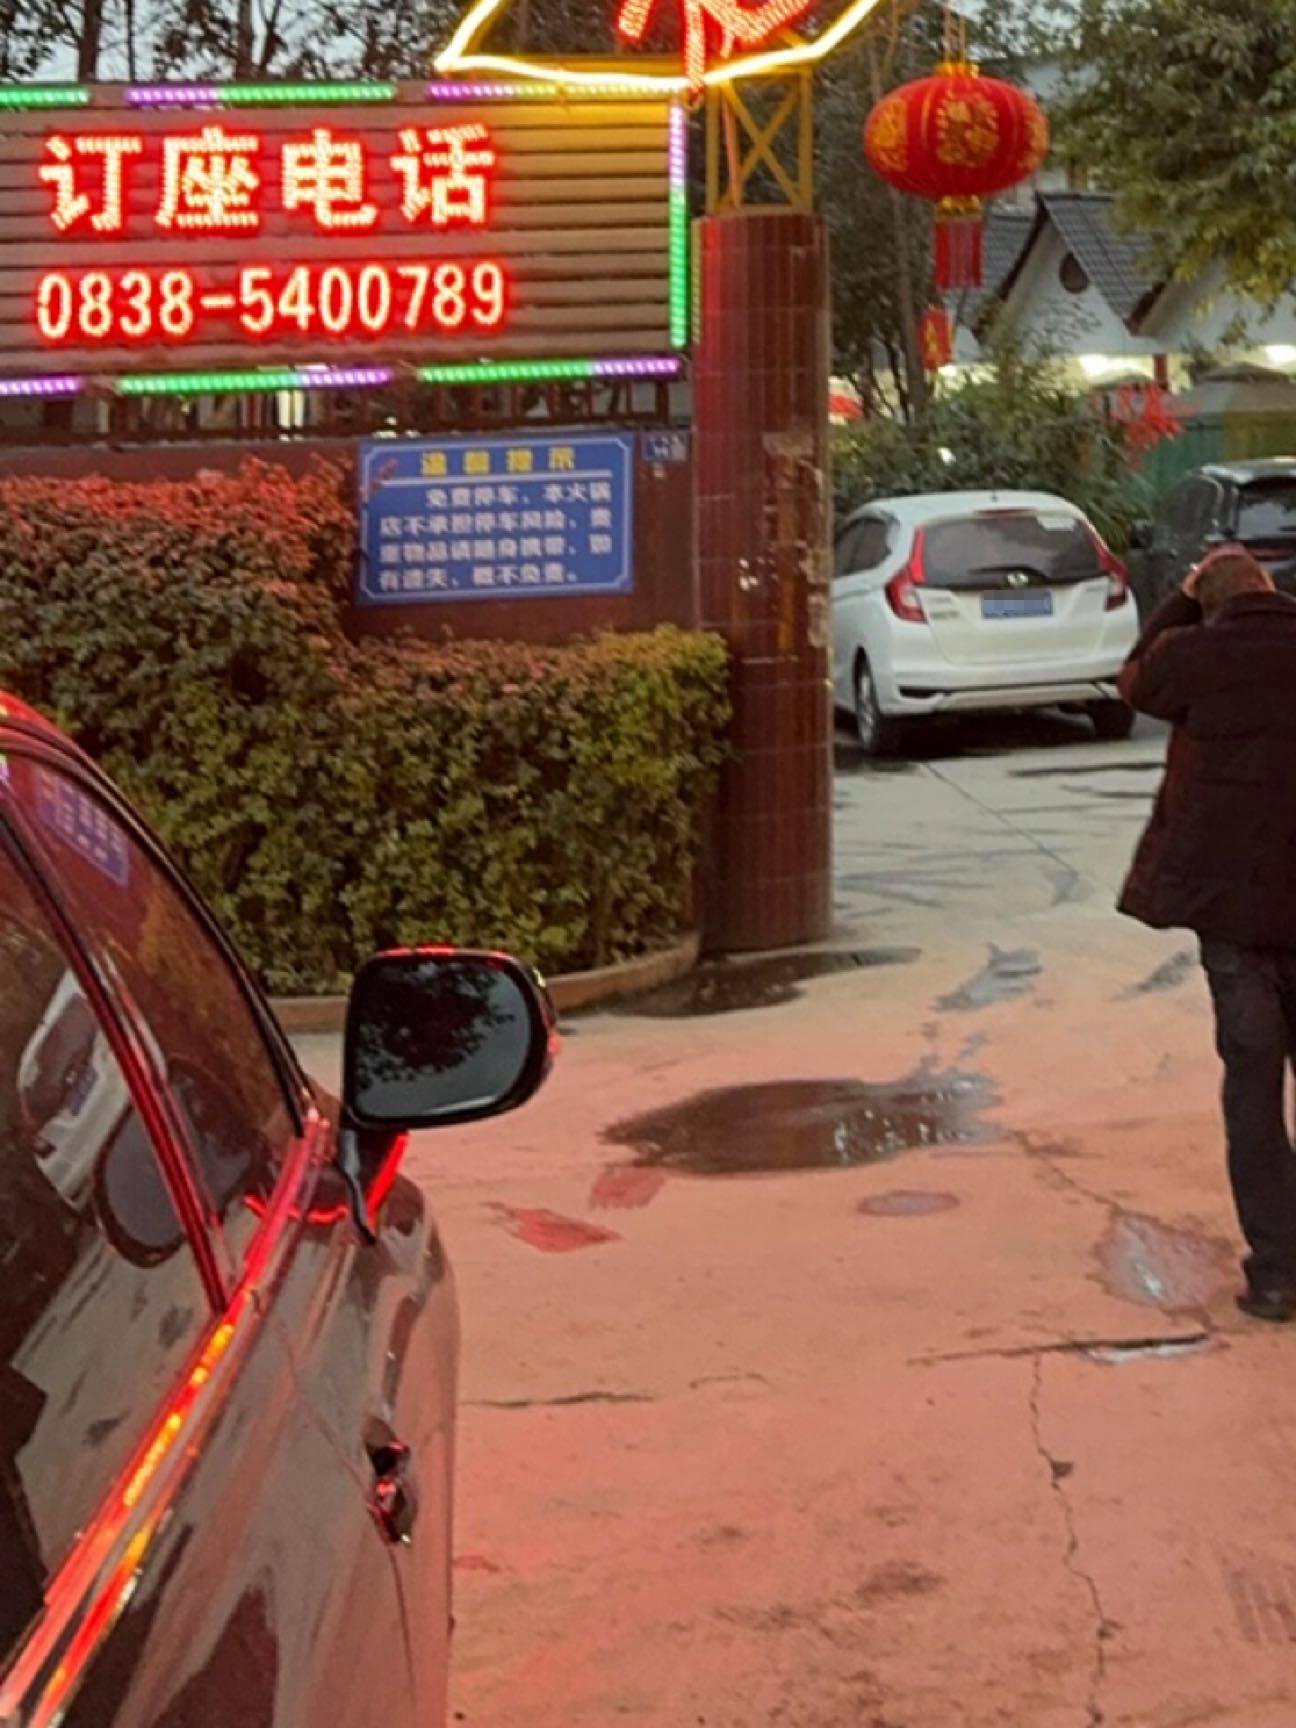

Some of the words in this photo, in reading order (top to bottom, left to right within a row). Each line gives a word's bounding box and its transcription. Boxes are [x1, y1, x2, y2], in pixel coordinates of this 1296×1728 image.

[39, 124, 495, 230] 订座电话
[37, 263, 503, 337] 0838-5400789
